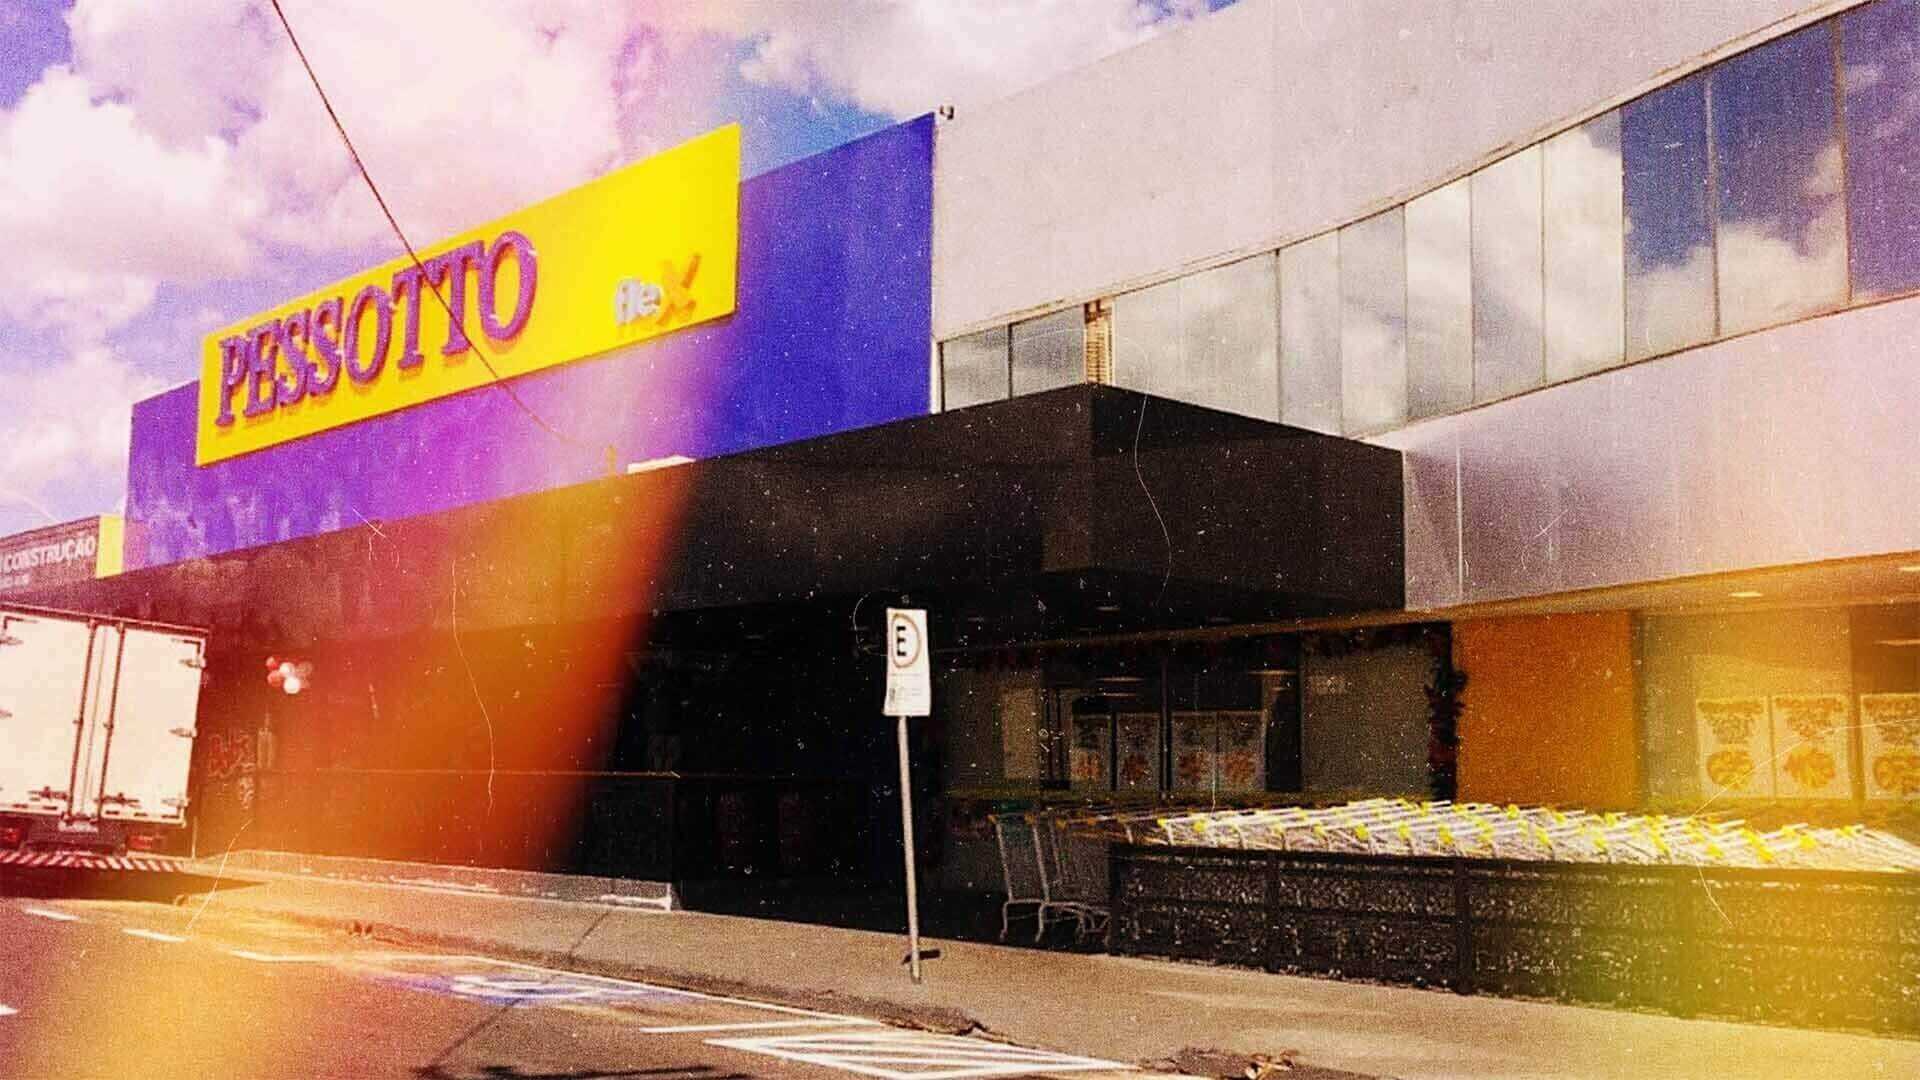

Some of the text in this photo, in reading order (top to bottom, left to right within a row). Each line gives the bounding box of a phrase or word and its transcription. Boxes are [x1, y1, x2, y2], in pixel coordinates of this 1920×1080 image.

[215, 230, 538, 426] PESSOTTO
[3, 532, 96, 573] CONSTRUÇÃO
[896, 626, 906, 656] E
